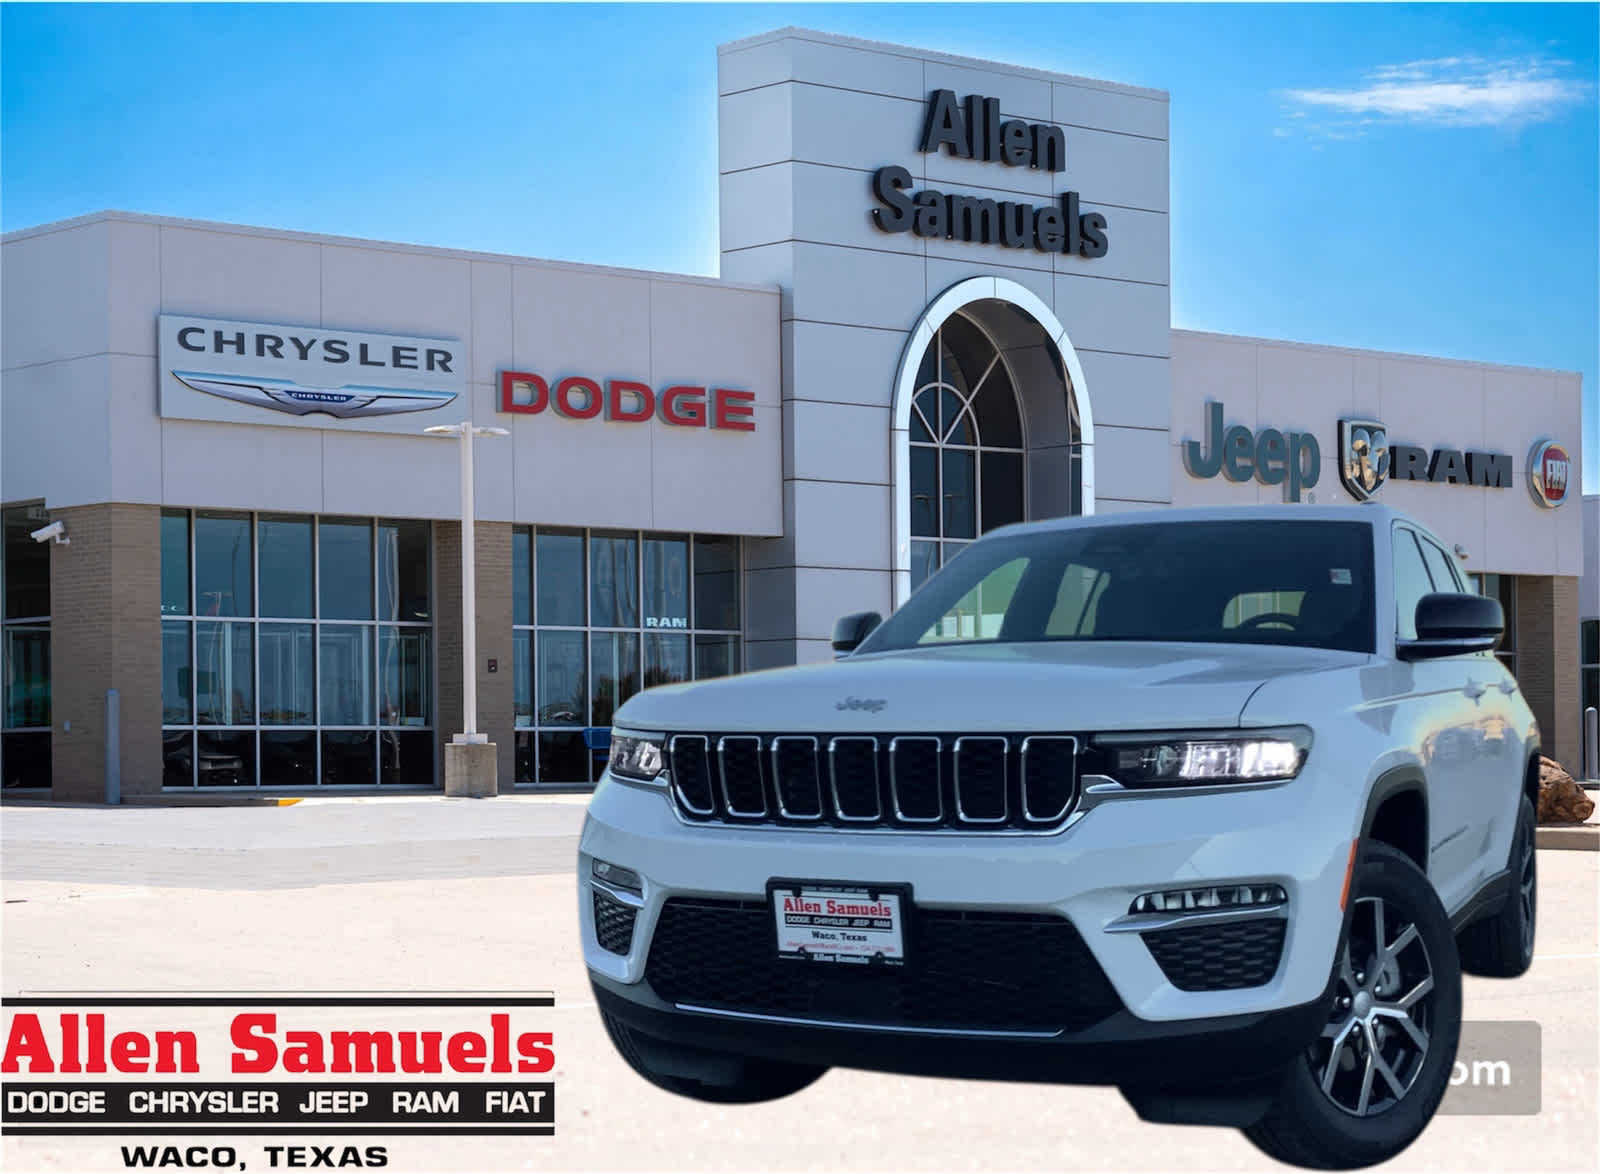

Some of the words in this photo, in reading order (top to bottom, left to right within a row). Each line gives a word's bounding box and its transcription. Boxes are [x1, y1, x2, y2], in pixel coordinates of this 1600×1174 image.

[918, 88, 1066, 173] Allen
[872, 165, 1108, 258] Samuels
[177, 326, 455, 374] CHRYSLER
[290, 392, 347, 401] CHRYSLER
[497, 370, 757, 432] DODGE
[1182, 400, 1321, 503] Jeep
[1389, 444, 1514, 489] RAM
[646, 617, 687, 628] RAM
[784, 897, 822, 914] Allen
[826, 899, 892, 917] Samuels
[786, 915, 811, 924] DODGE
[813, 916, 849, 926] CHRYSLER
[852, 918, 870, 927] JEEP
[873, 919, 892, 929] RAM
[811, 930, 839, 942] Waco,
[840, 932, 868, 942] Texas
